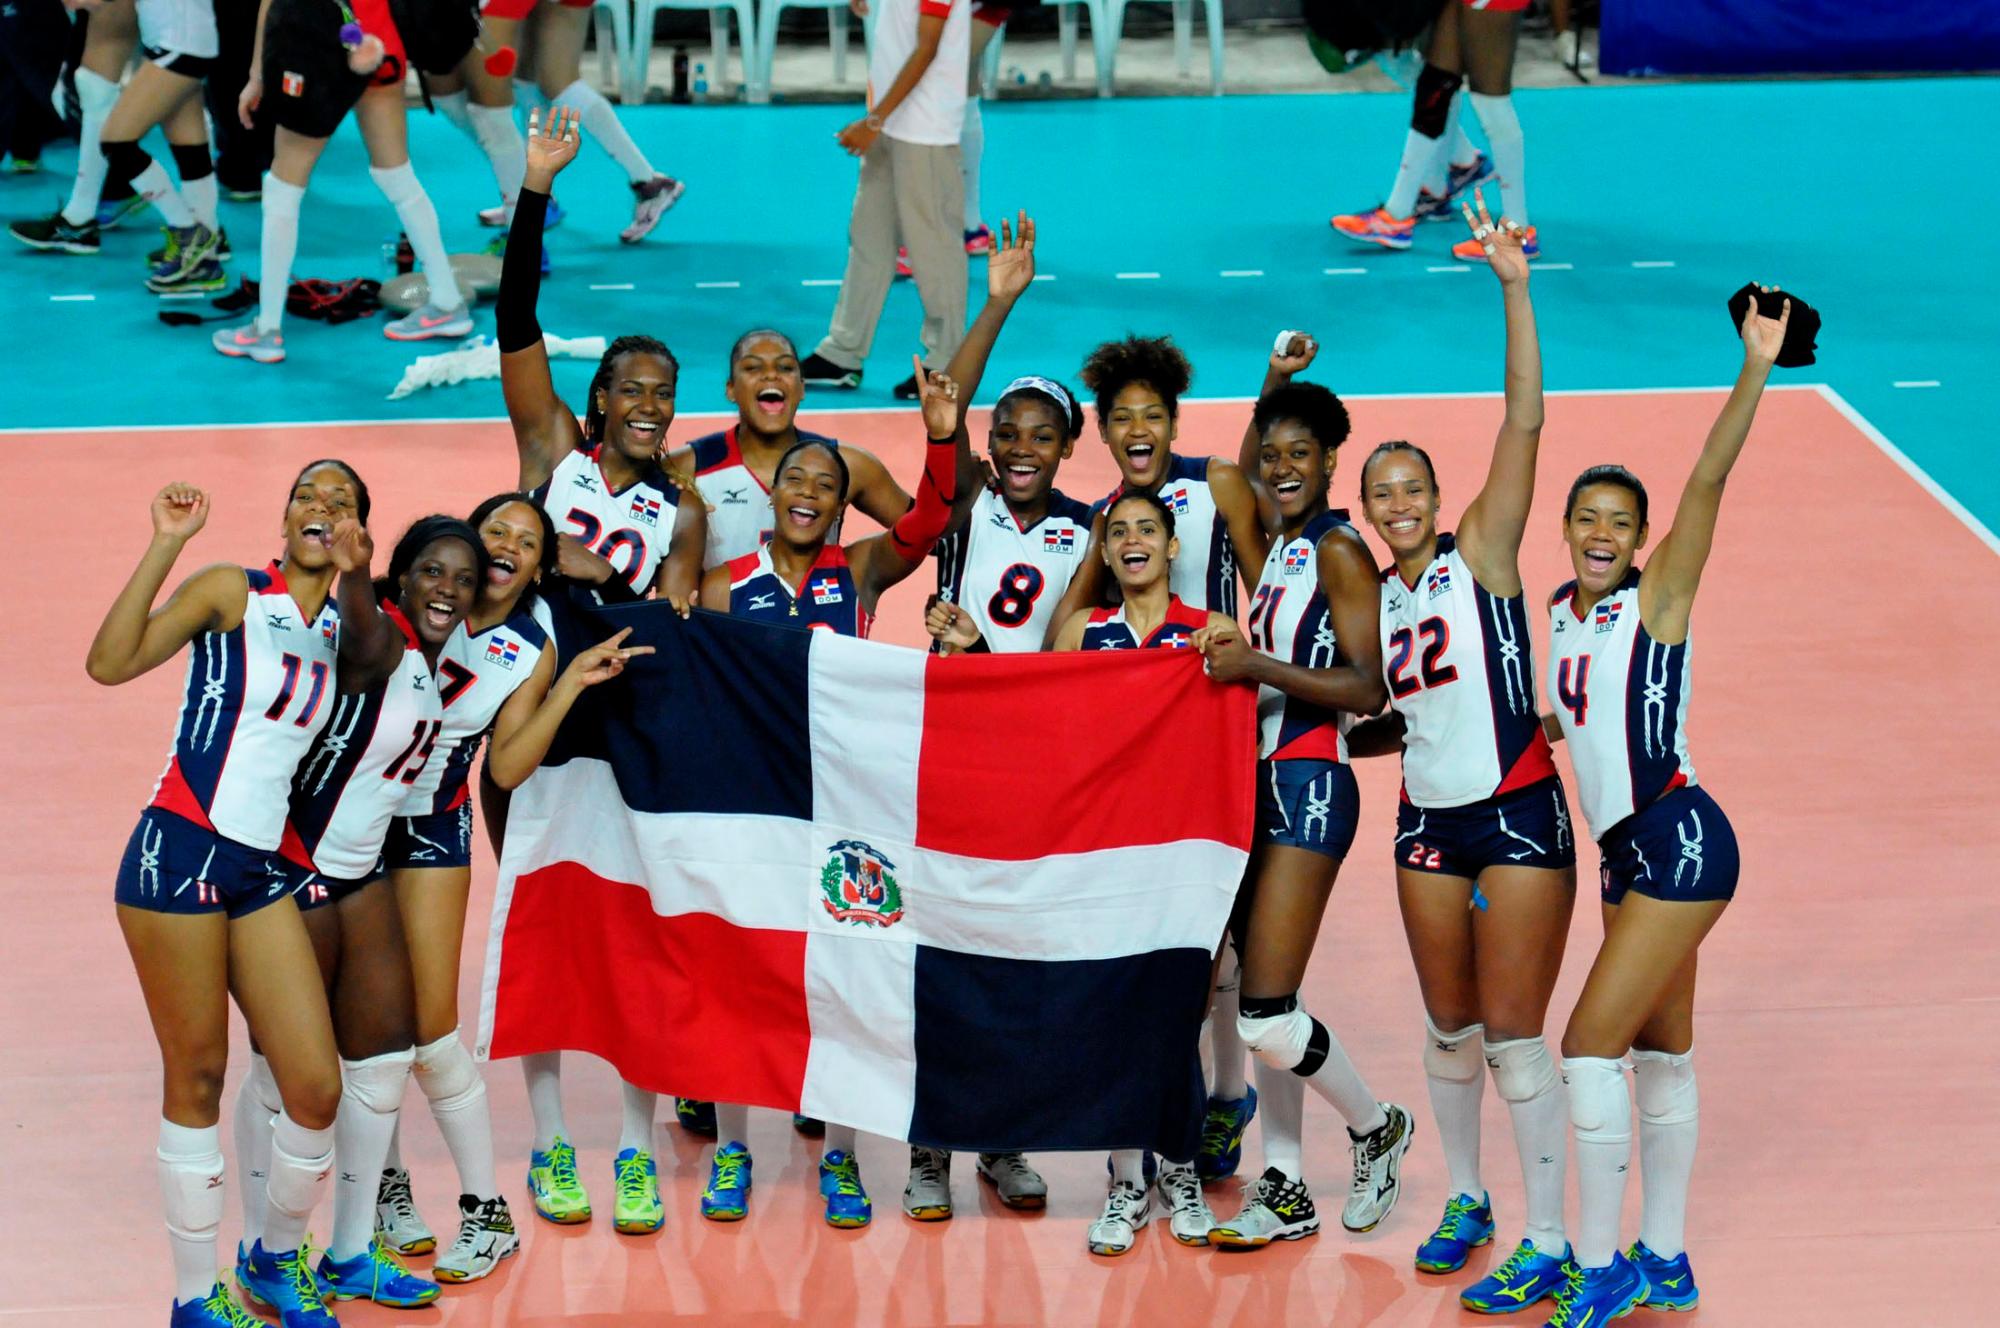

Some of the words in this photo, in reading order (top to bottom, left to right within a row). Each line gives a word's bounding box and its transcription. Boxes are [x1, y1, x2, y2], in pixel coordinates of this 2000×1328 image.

[633, 512, 653, 523] DOM
[1048, 544, 1069, 552] DOM
[818, 595, 839, 604] DOM
[987, 562, 1045, 629] 8
[1432, 582, 1451, 597] DOM
[1248, 583, 1287, 654] 21
[488, 653, 510, 667] DOM
[1387, 615, 1459, 700] 22
[264, 652, 331, 728] 11
[438, 656, 480, 710] 7
[1557, 654, 1592, 726] 4
[382, 719, 443, 785] 15
[1407, 842, 1442, 870] 22
[196, 880, 220, 905] 11
